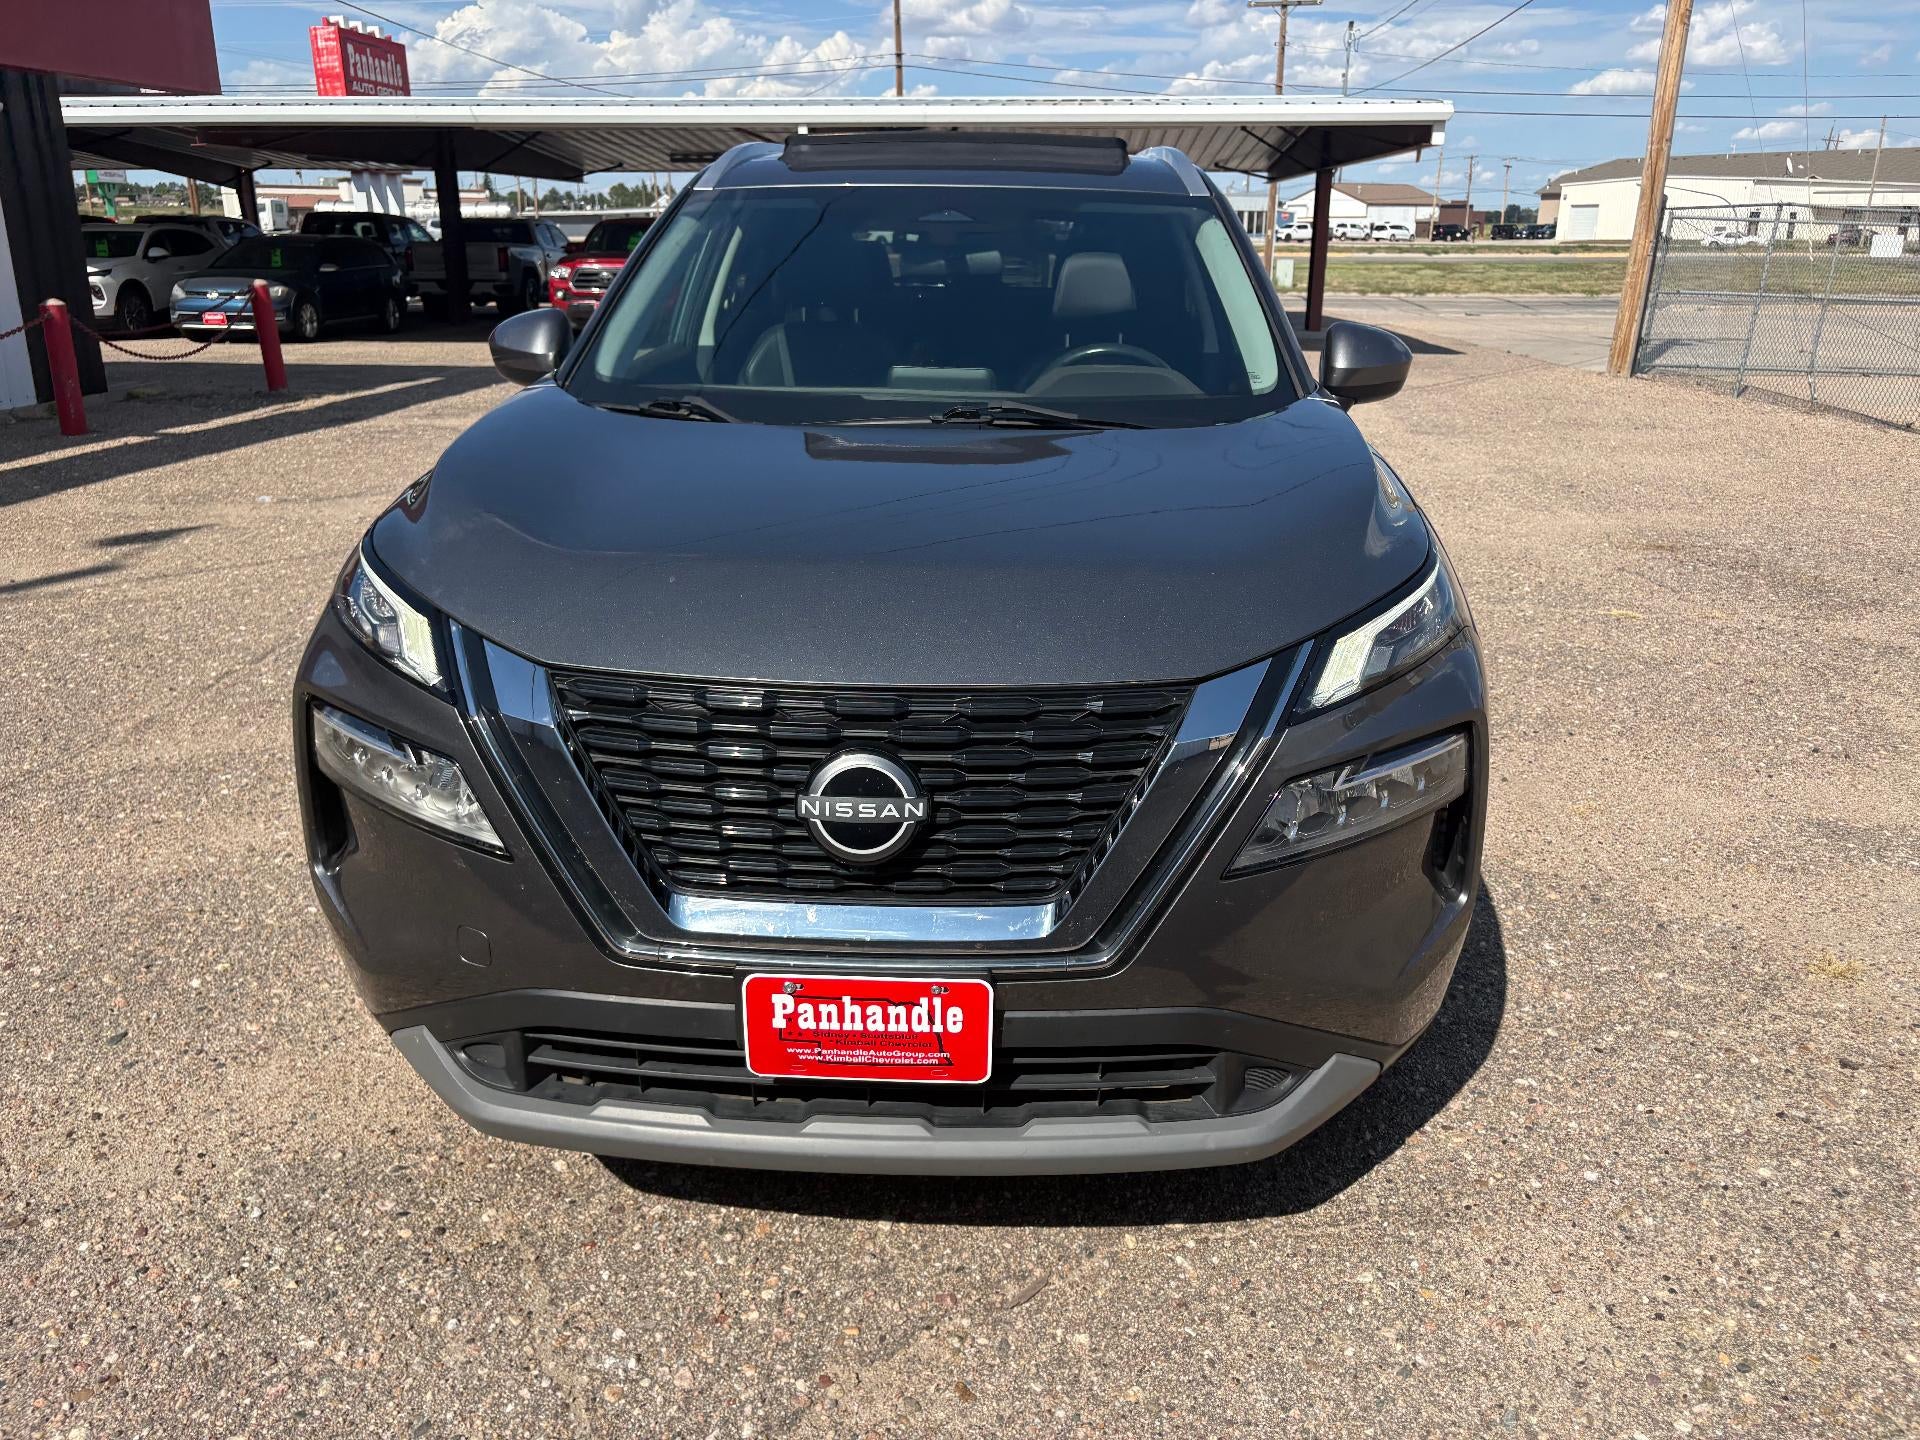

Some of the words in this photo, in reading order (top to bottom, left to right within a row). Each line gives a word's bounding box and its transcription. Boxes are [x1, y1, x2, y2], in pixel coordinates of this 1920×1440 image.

[347, 42, 403, 87] Panhandle
[352, 81, 375, 94] AUTO
[801, 799, 923, 817] NISSAN
[771, 993, 964, 1033] Panhandle
[813, 1031, 850, 1039] Sidney
[835, 1039, 877, 1047] Kimball
[880, 1040, 933, 1048] Chevrolet
[786, 1047, 950, 1058] www.PanhandleAutoGroup.com
[798, 1054, 939, 1065] www.KimballChevrolet.com
